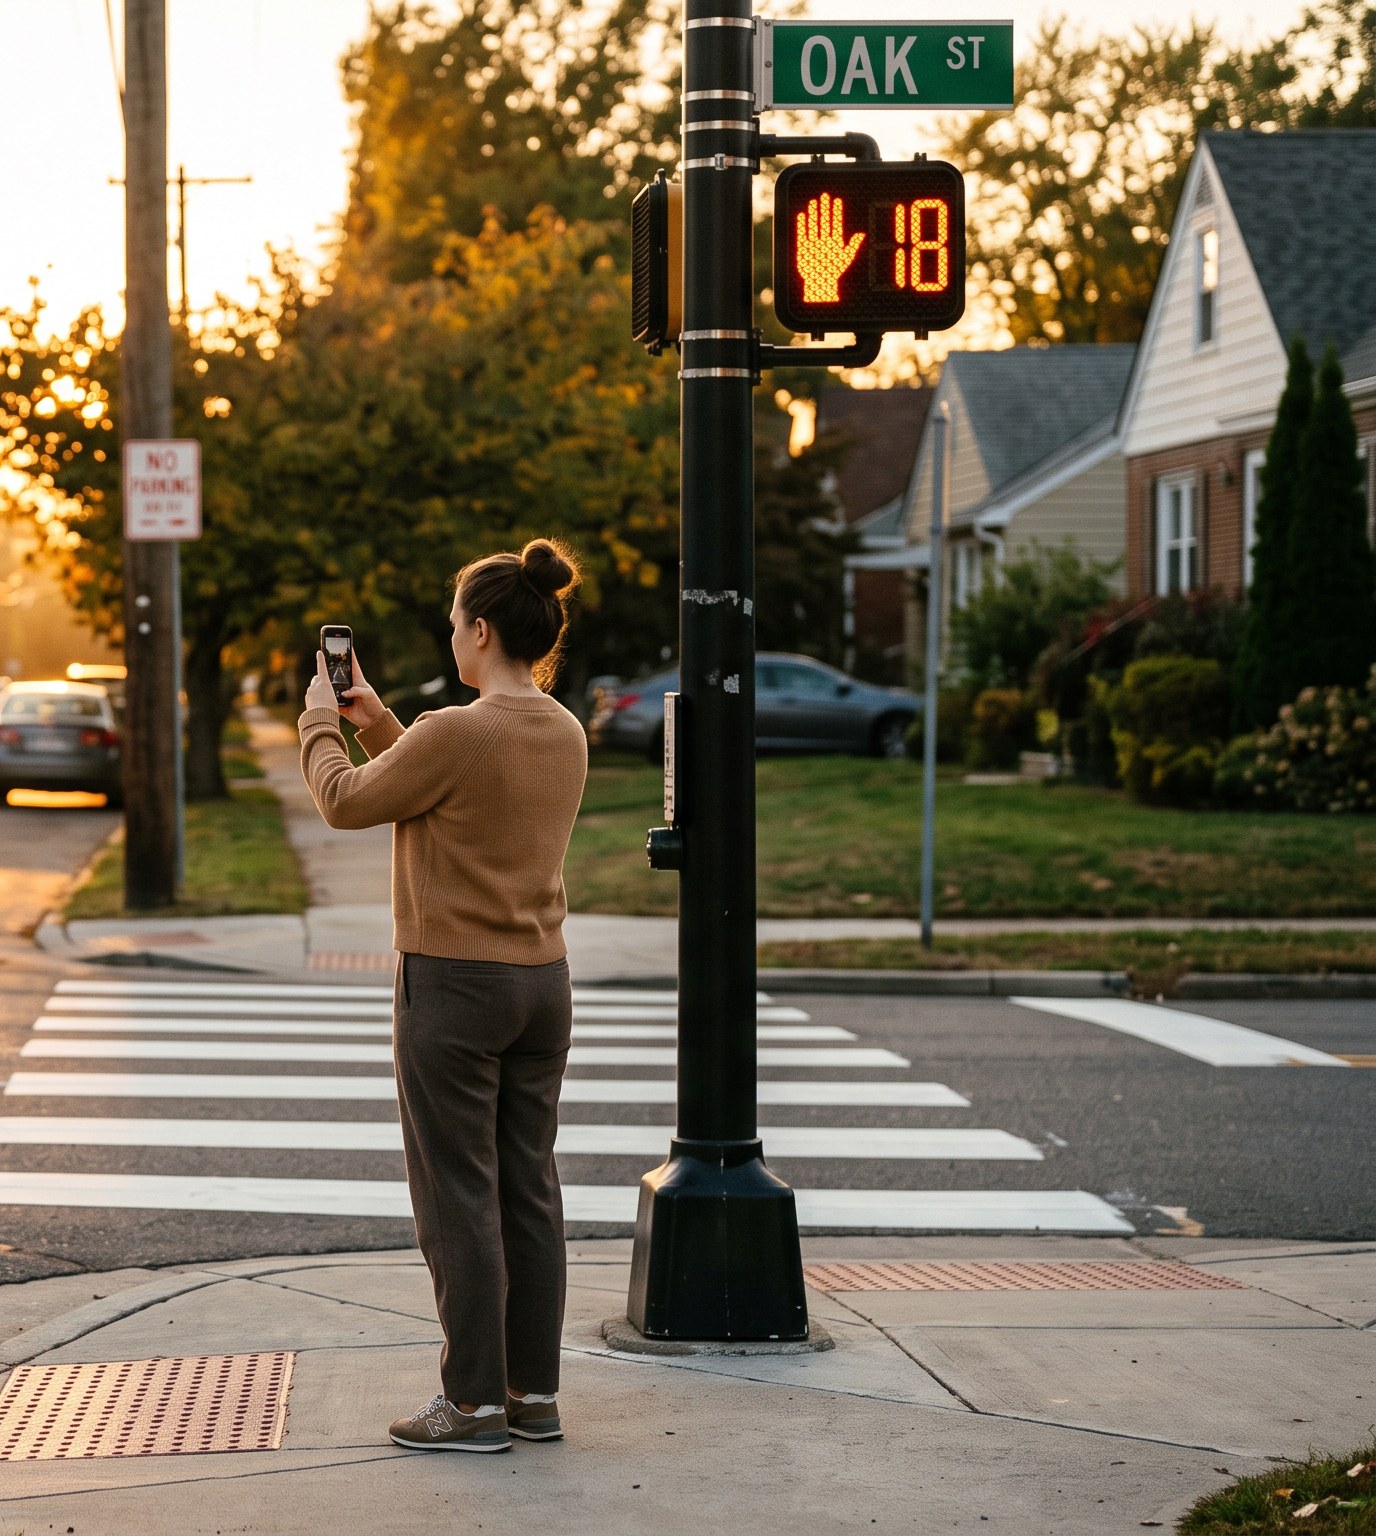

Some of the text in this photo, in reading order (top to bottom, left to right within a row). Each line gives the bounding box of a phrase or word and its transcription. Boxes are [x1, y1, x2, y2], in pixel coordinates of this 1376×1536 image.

[800, 34, 985, 96] OAK ST
[893, 197, 949, 293] 18
[146, 449, 179, 472] NO
[425, 1411, 453, 1438] N
